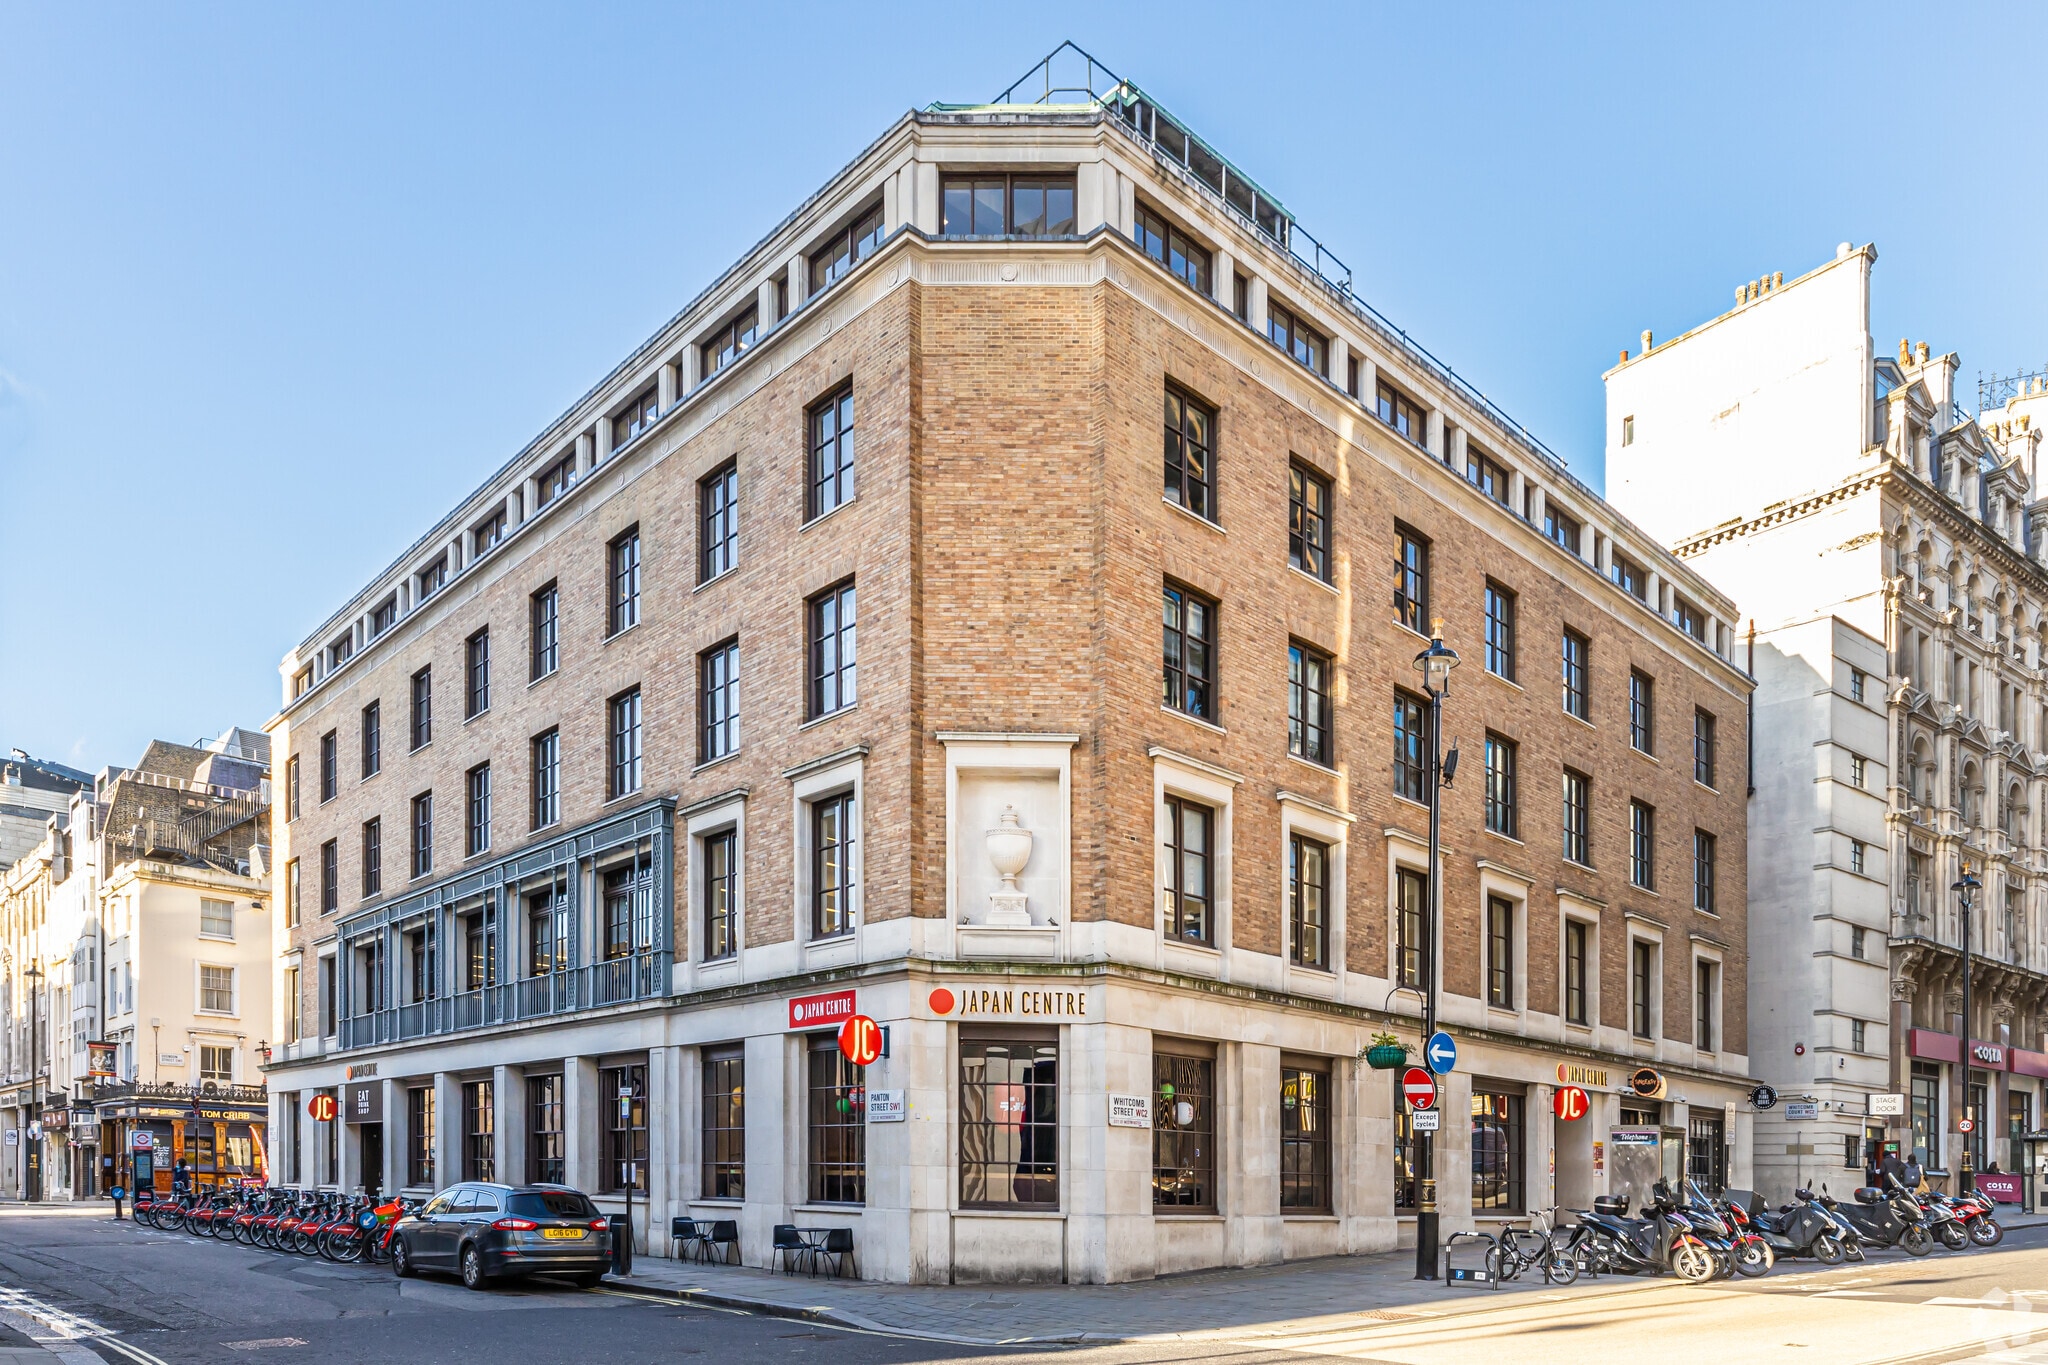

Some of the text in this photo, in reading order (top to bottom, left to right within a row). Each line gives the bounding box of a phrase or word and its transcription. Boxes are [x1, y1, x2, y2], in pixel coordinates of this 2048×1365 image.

[960, 990, 1086, 1015] JAPAN CENTRE
[805, 998, 851, 1020] JAPAN CENTRE
[851, 1019, 875, 1063] JC
[1977, 1045, 2002, 1063] COSTA
[1567, 1065, 1608, 1087] JAPAN CENTRE
[358, 1090, 370, 1101] EAT
[871, 1093, 890, 1101] PANTON
[315, 1096, 333, 1120] JC
[871, 1102, 901, 1111] STREET SW1
[1113, 1097, 1145, 1108] WHITCOMB
[1560, 1088, 1581, 1120] JC
[200, 1110, 250, 1120] TOM CRIBB
[1113, 1107, 1148, 1118] STREET WC2
[1415, 1113, 1437, 1121] Except
[1620, 1133, 1649, 1142] Telephone
[1986, 1182, 2013, 1190] COSTA
